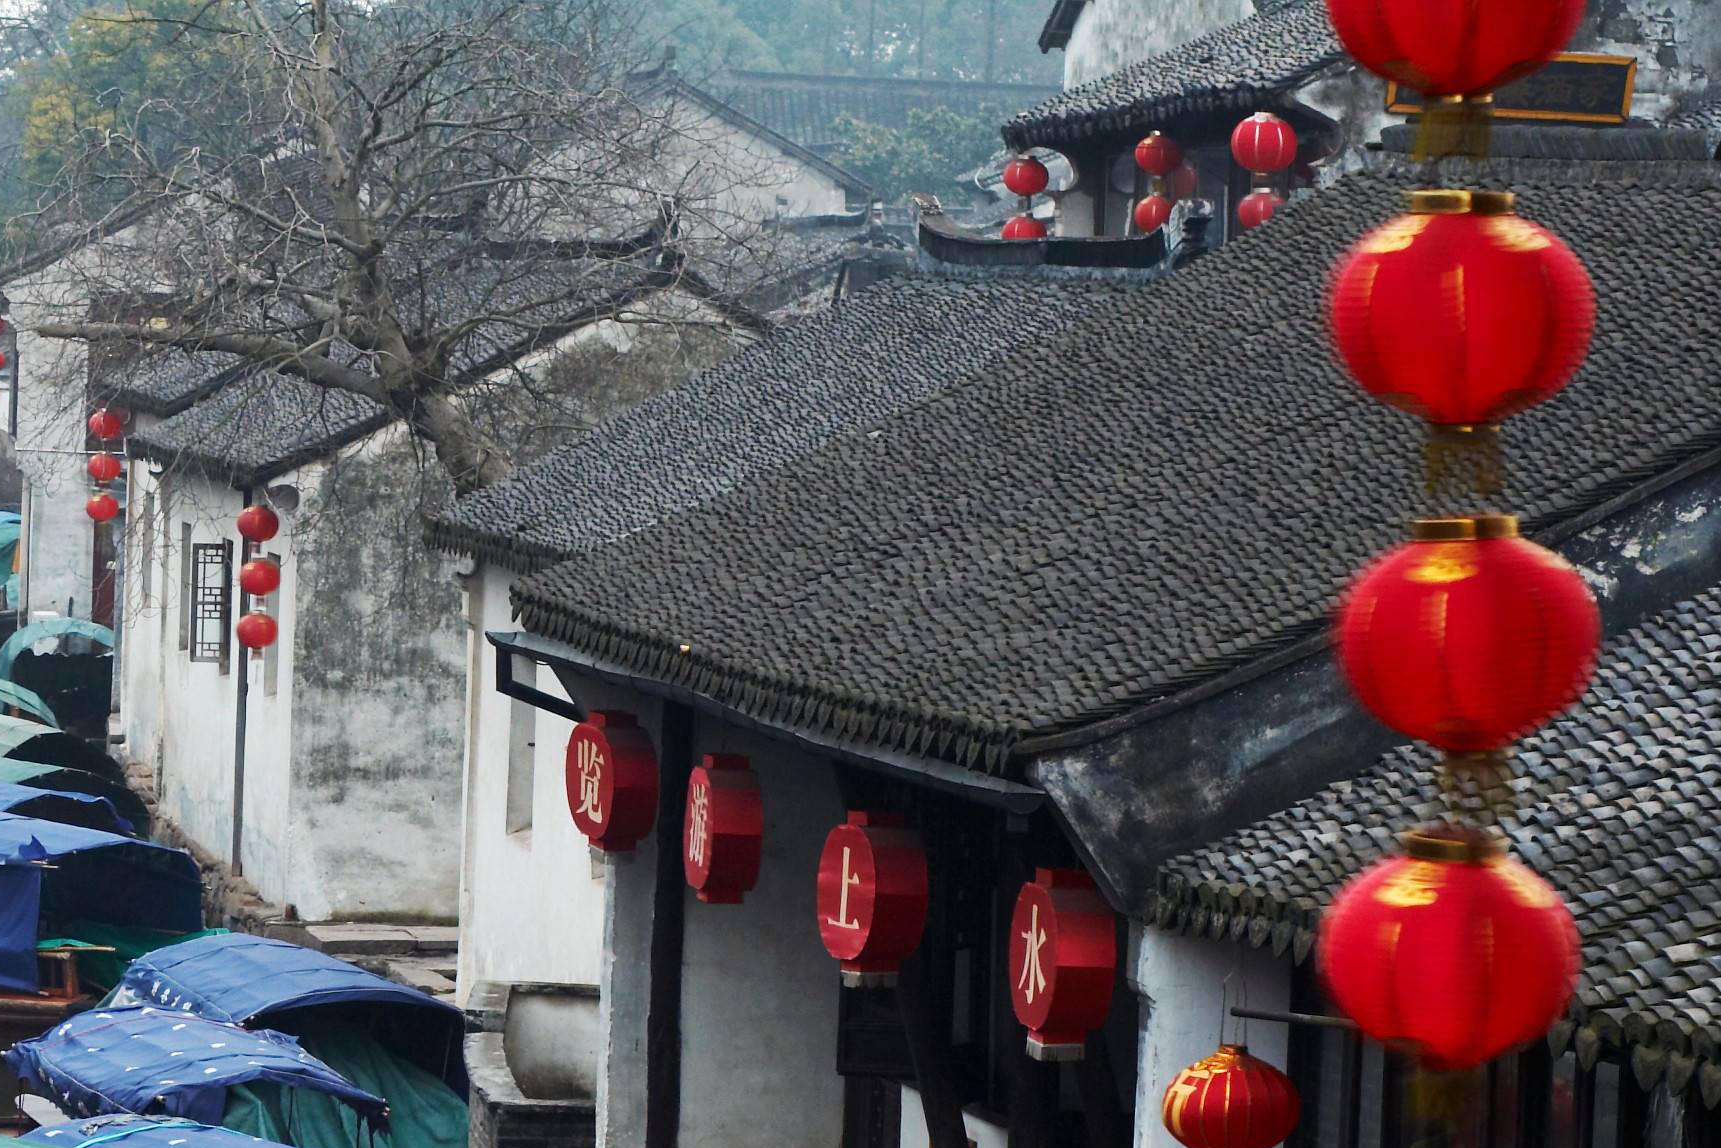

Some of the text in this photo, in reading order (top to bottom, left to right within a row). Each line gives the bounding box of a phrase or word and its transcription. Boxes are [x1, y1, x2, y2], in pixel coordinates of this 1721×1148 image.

[576, 739, 605, 824] 览
[689, 784, 708, 867] 游
[827, 846, 860, 930] 上
[1018, 904, 1047, 1005] 水
